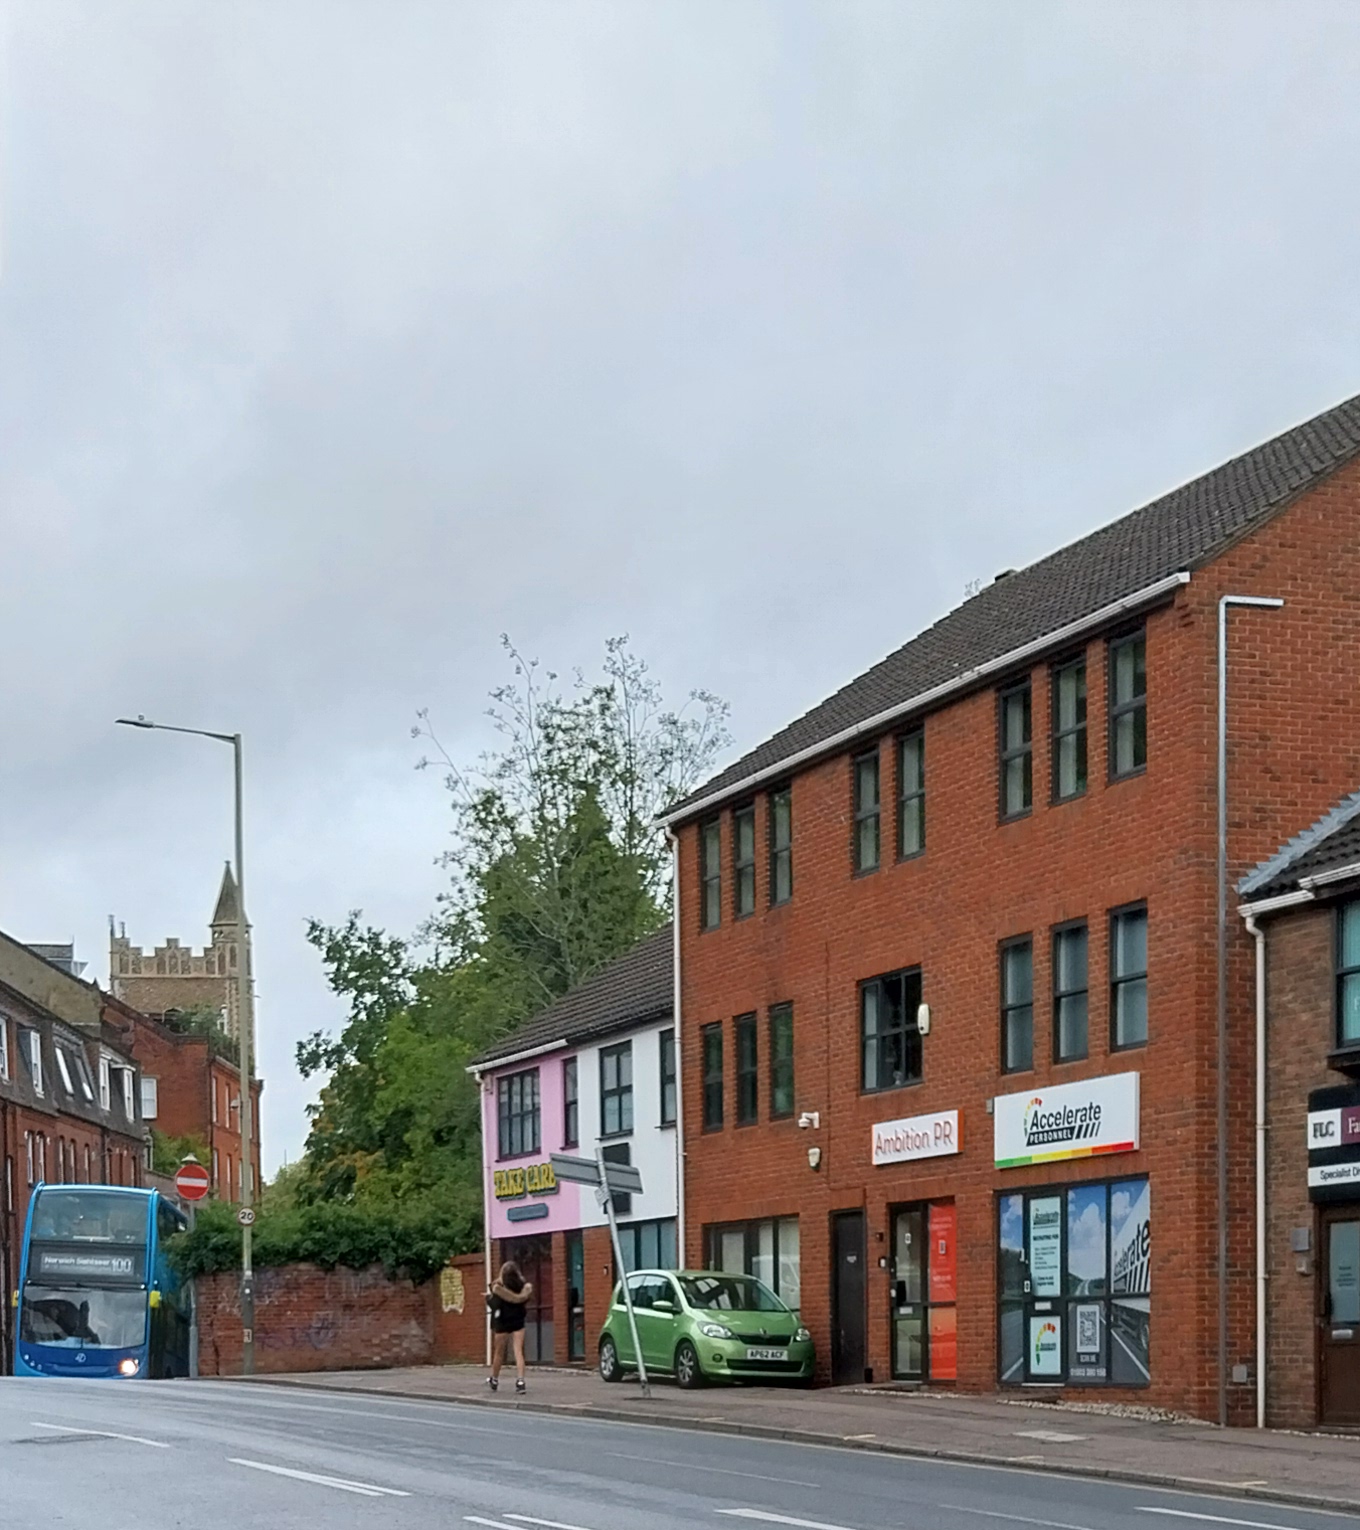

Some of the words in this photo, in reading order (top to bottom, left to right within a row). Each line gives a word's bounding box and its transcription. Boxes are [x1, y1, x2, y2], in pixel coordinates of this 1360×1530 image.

[1029, 1102, 1101, 1131] Accelerate
[875, 1127, 930, 1156] Ambition
[934, 1120, 953, 1147] PR
[1029, 1129, 1072, 1143] PERSONNEL
[1313, 1121, 1335, 1139] FLC
[494, 1167, 524, 1196] TAKE
[1320, 1168, 1351, 1181] Specialist
[240, 1211, 253, 1220] 20
[111, 1258, 132, 1273] 100
